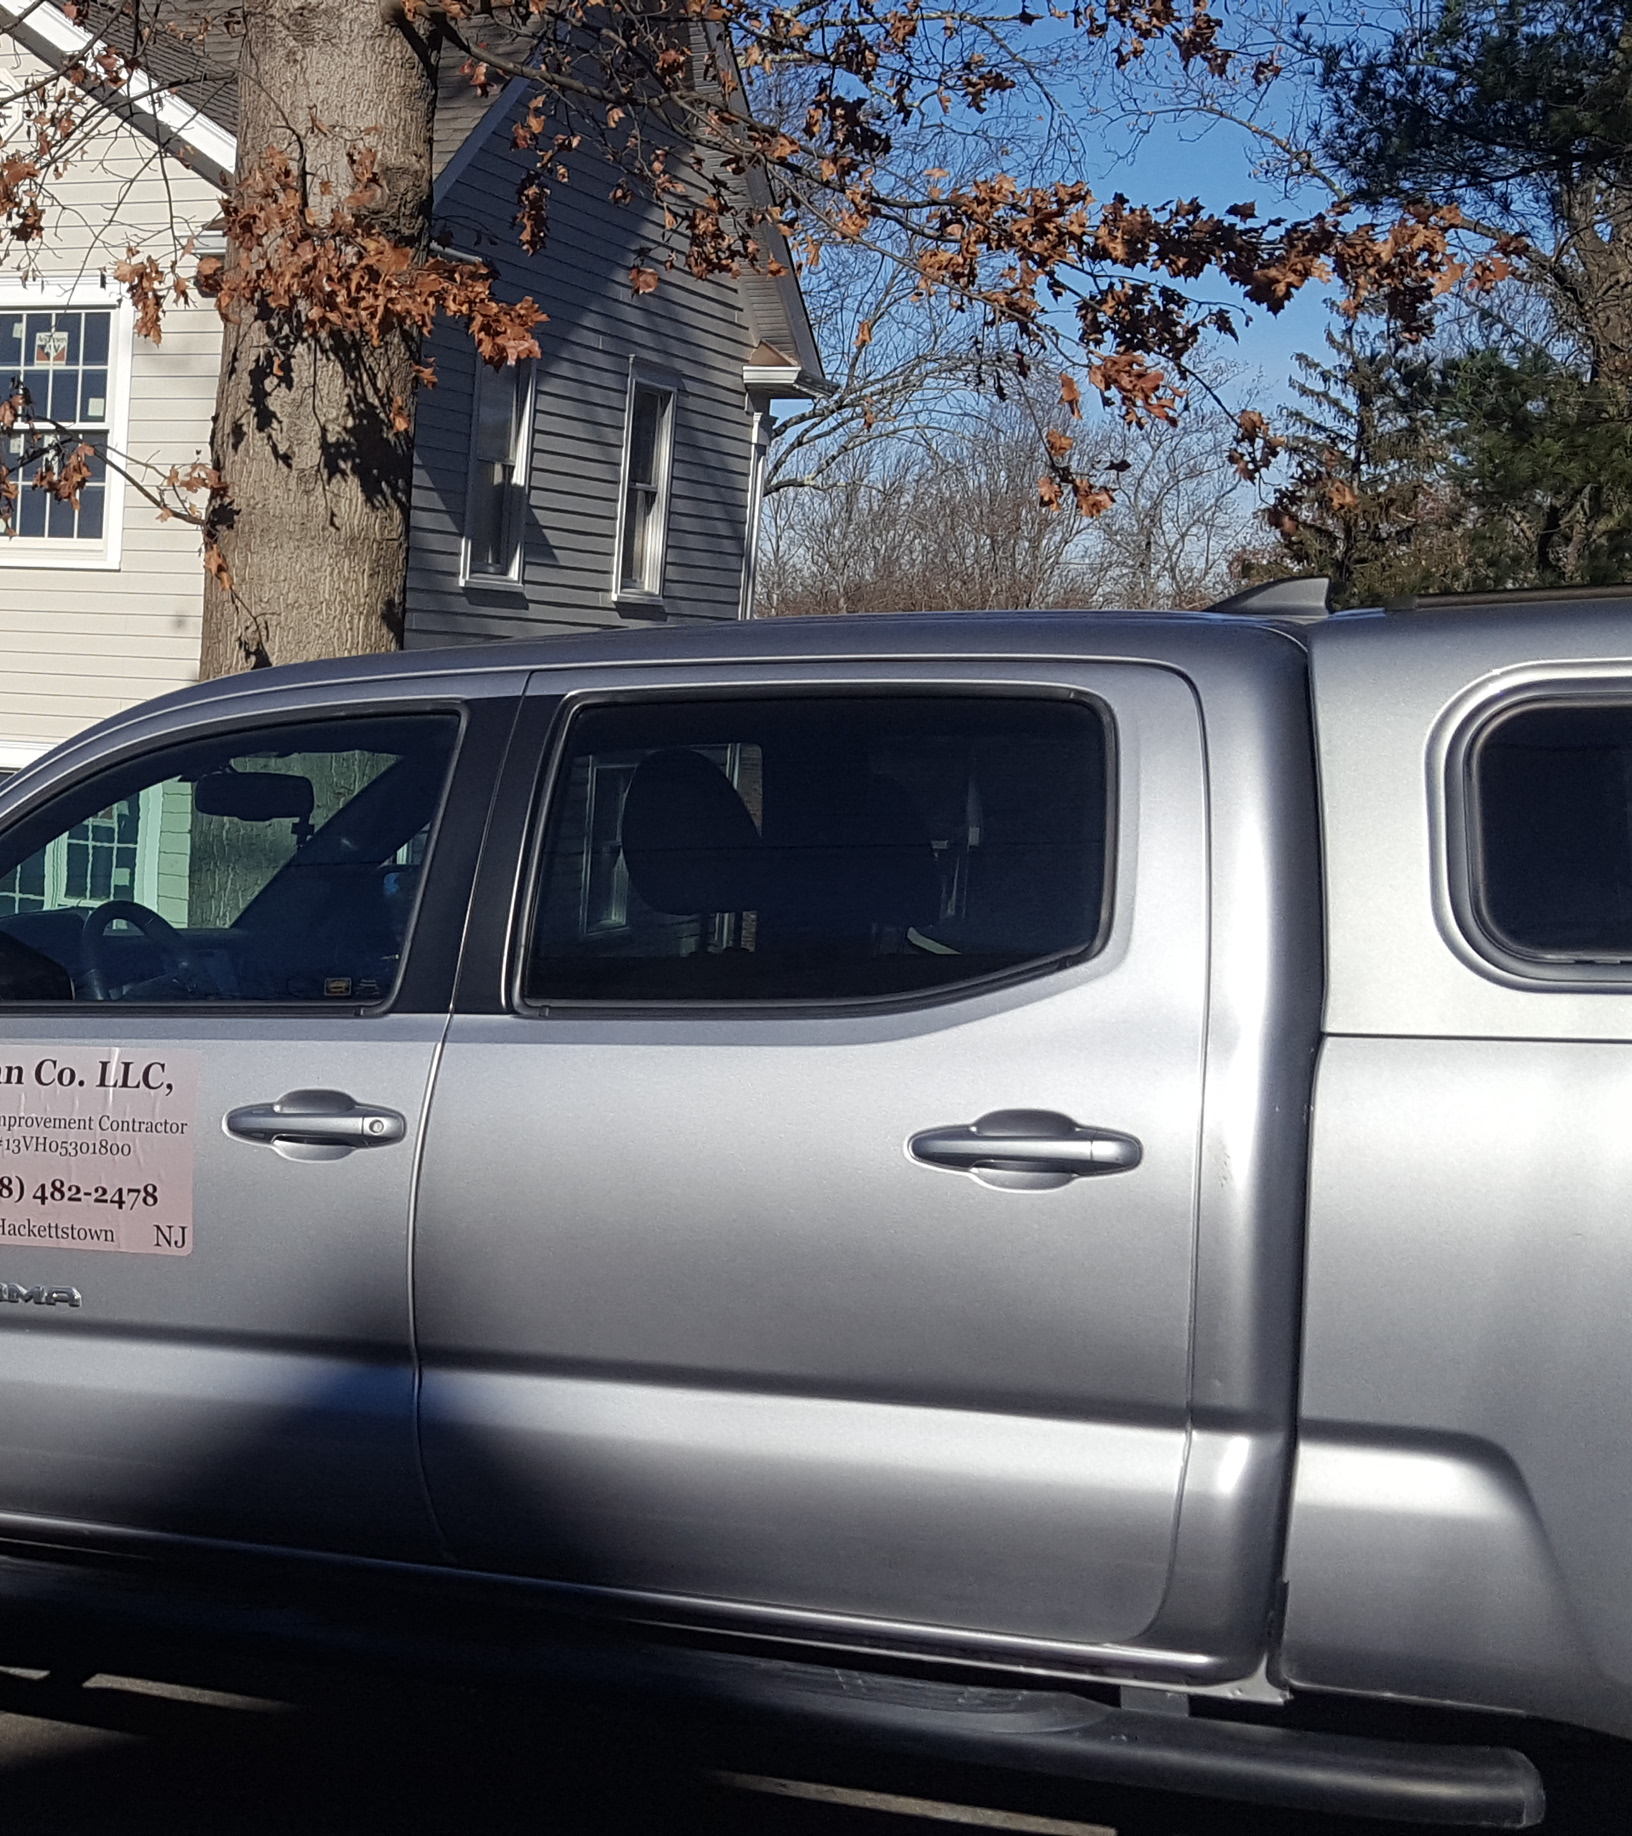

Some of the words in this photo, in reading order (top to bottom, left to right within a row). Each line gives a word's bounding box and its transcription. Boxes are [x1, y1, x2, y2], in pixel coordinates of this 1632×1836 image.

[35, 1059, 85, 1088] Co.
[95, 1060, 174, 1097] LLC,
[99, 1112, 188, 1134] Contractor
[32, 1178, 158, 1210] 482-2478
[153, 1224, 187, 1248] NJ
